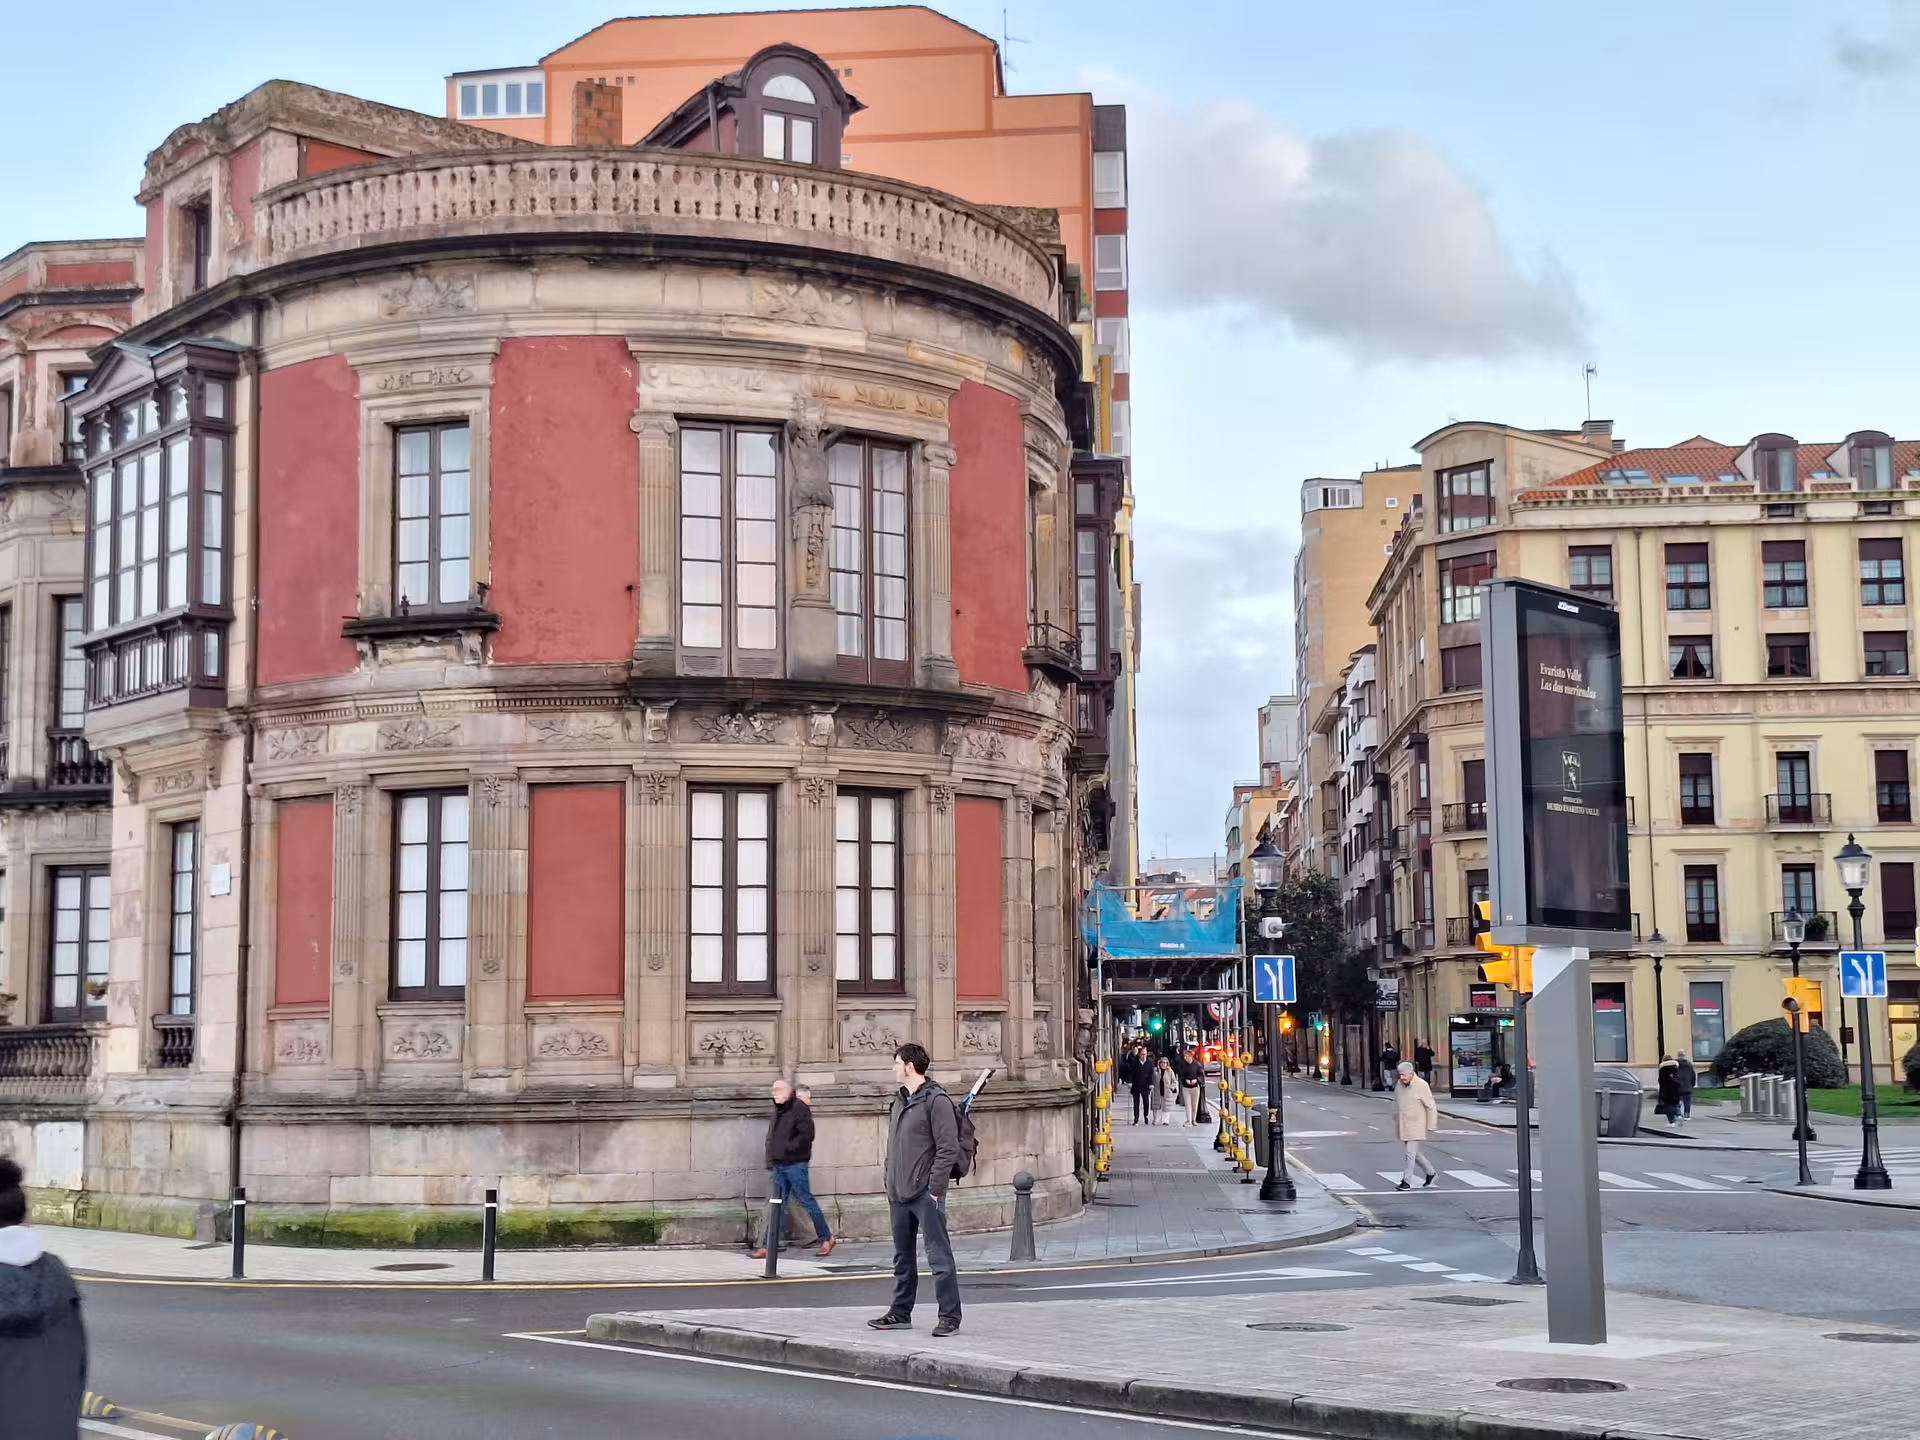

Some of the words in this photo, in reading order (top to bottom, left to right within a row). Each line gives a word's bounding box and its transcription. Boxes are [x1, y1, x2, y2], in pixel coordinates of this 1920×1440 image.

[1540, 663, 1565, 678] Evaristo
[1566, 668, 1582, 682] Valle
[1540, 678, 1551, 690] Las
[1553, 680, 1563, 693] dos
[1564, 685, 1596, 699] meriendas
